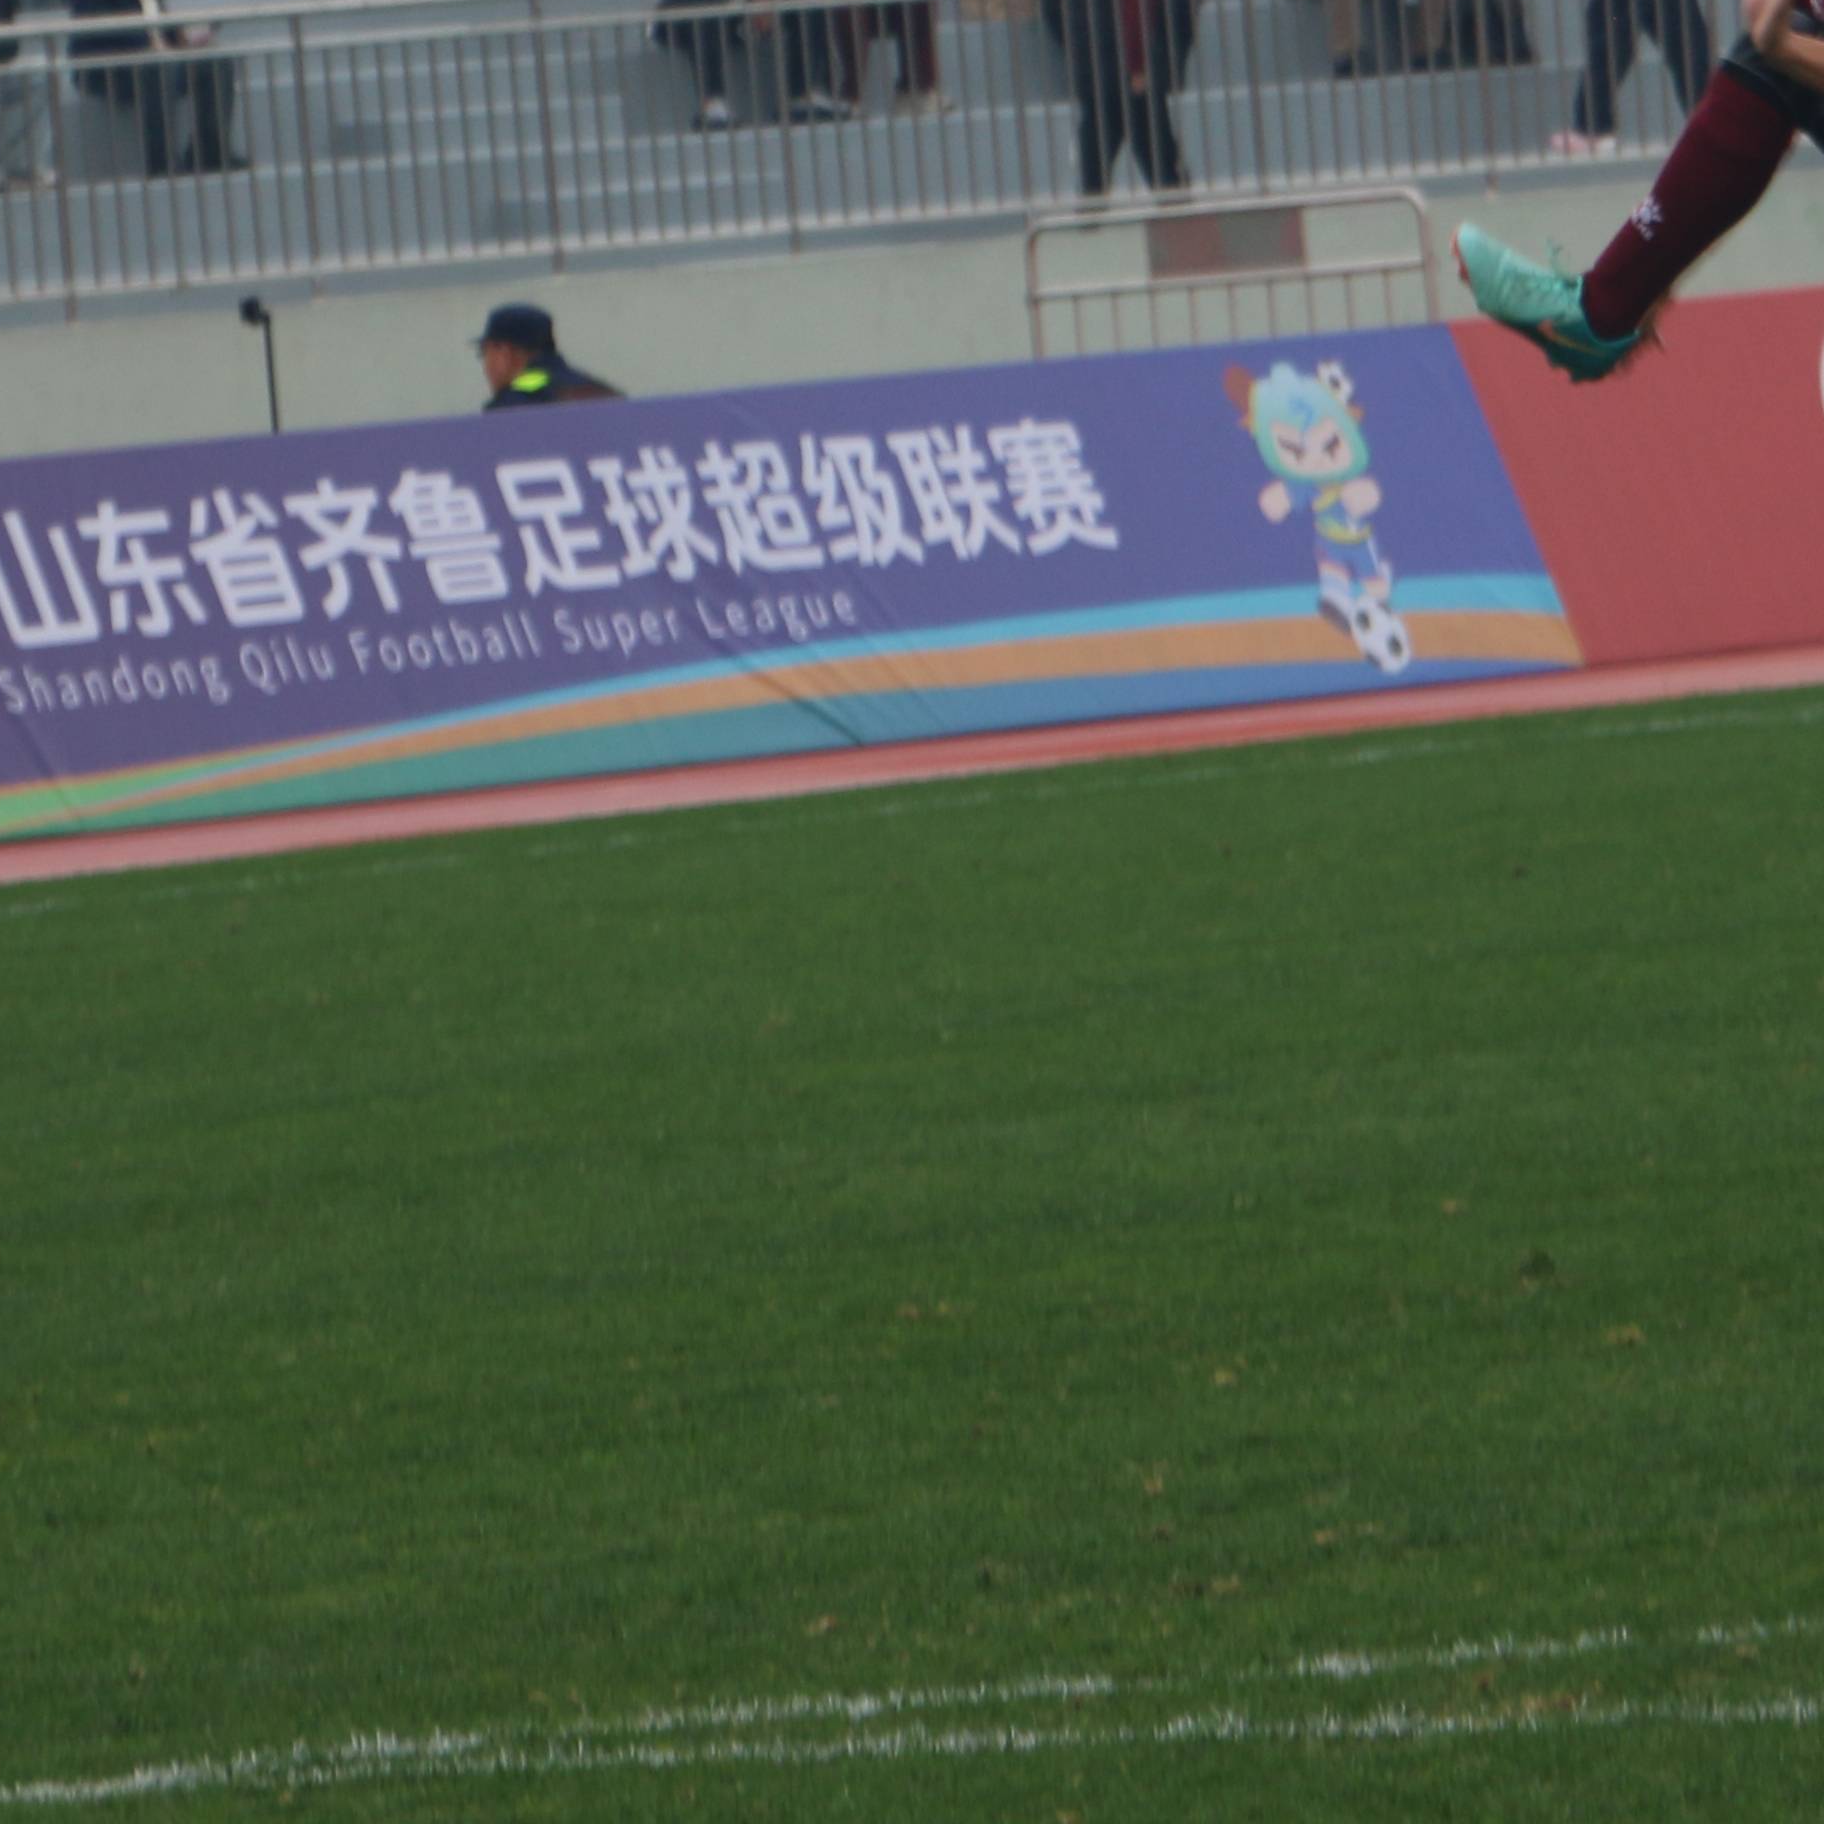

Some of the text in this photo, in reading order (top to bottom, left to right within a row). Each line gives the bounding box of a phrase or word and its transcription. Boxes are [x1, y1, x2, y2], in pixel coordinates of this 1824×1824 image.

[2, 644, 233, 716] Shandong
[239, 633, 336, 693] Qilu
[348, 610, 543, 676] Football
[560, 597, 683, 659] Super
[695, 588, 859, 644] League
